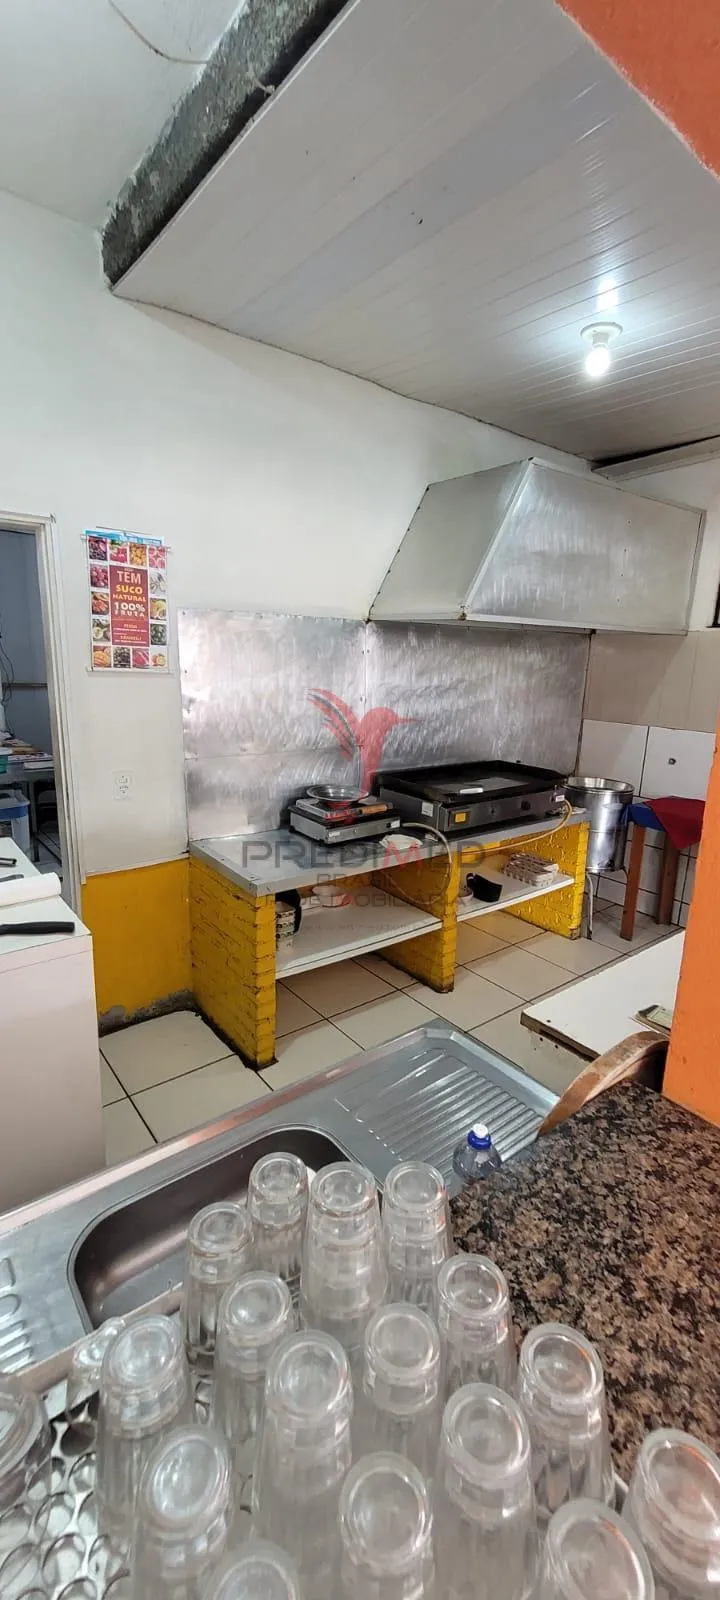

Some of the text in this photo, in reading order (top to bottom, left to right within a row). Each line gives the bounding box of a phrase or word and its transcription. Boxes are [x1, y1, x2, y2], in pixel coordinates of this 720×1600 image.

[117, 570, 141, 584] TEM
[116, 584, 143, 594] SUCO
[112, 594, 146, 602] NATURAL
[114, 602, 145, 613] 100%
